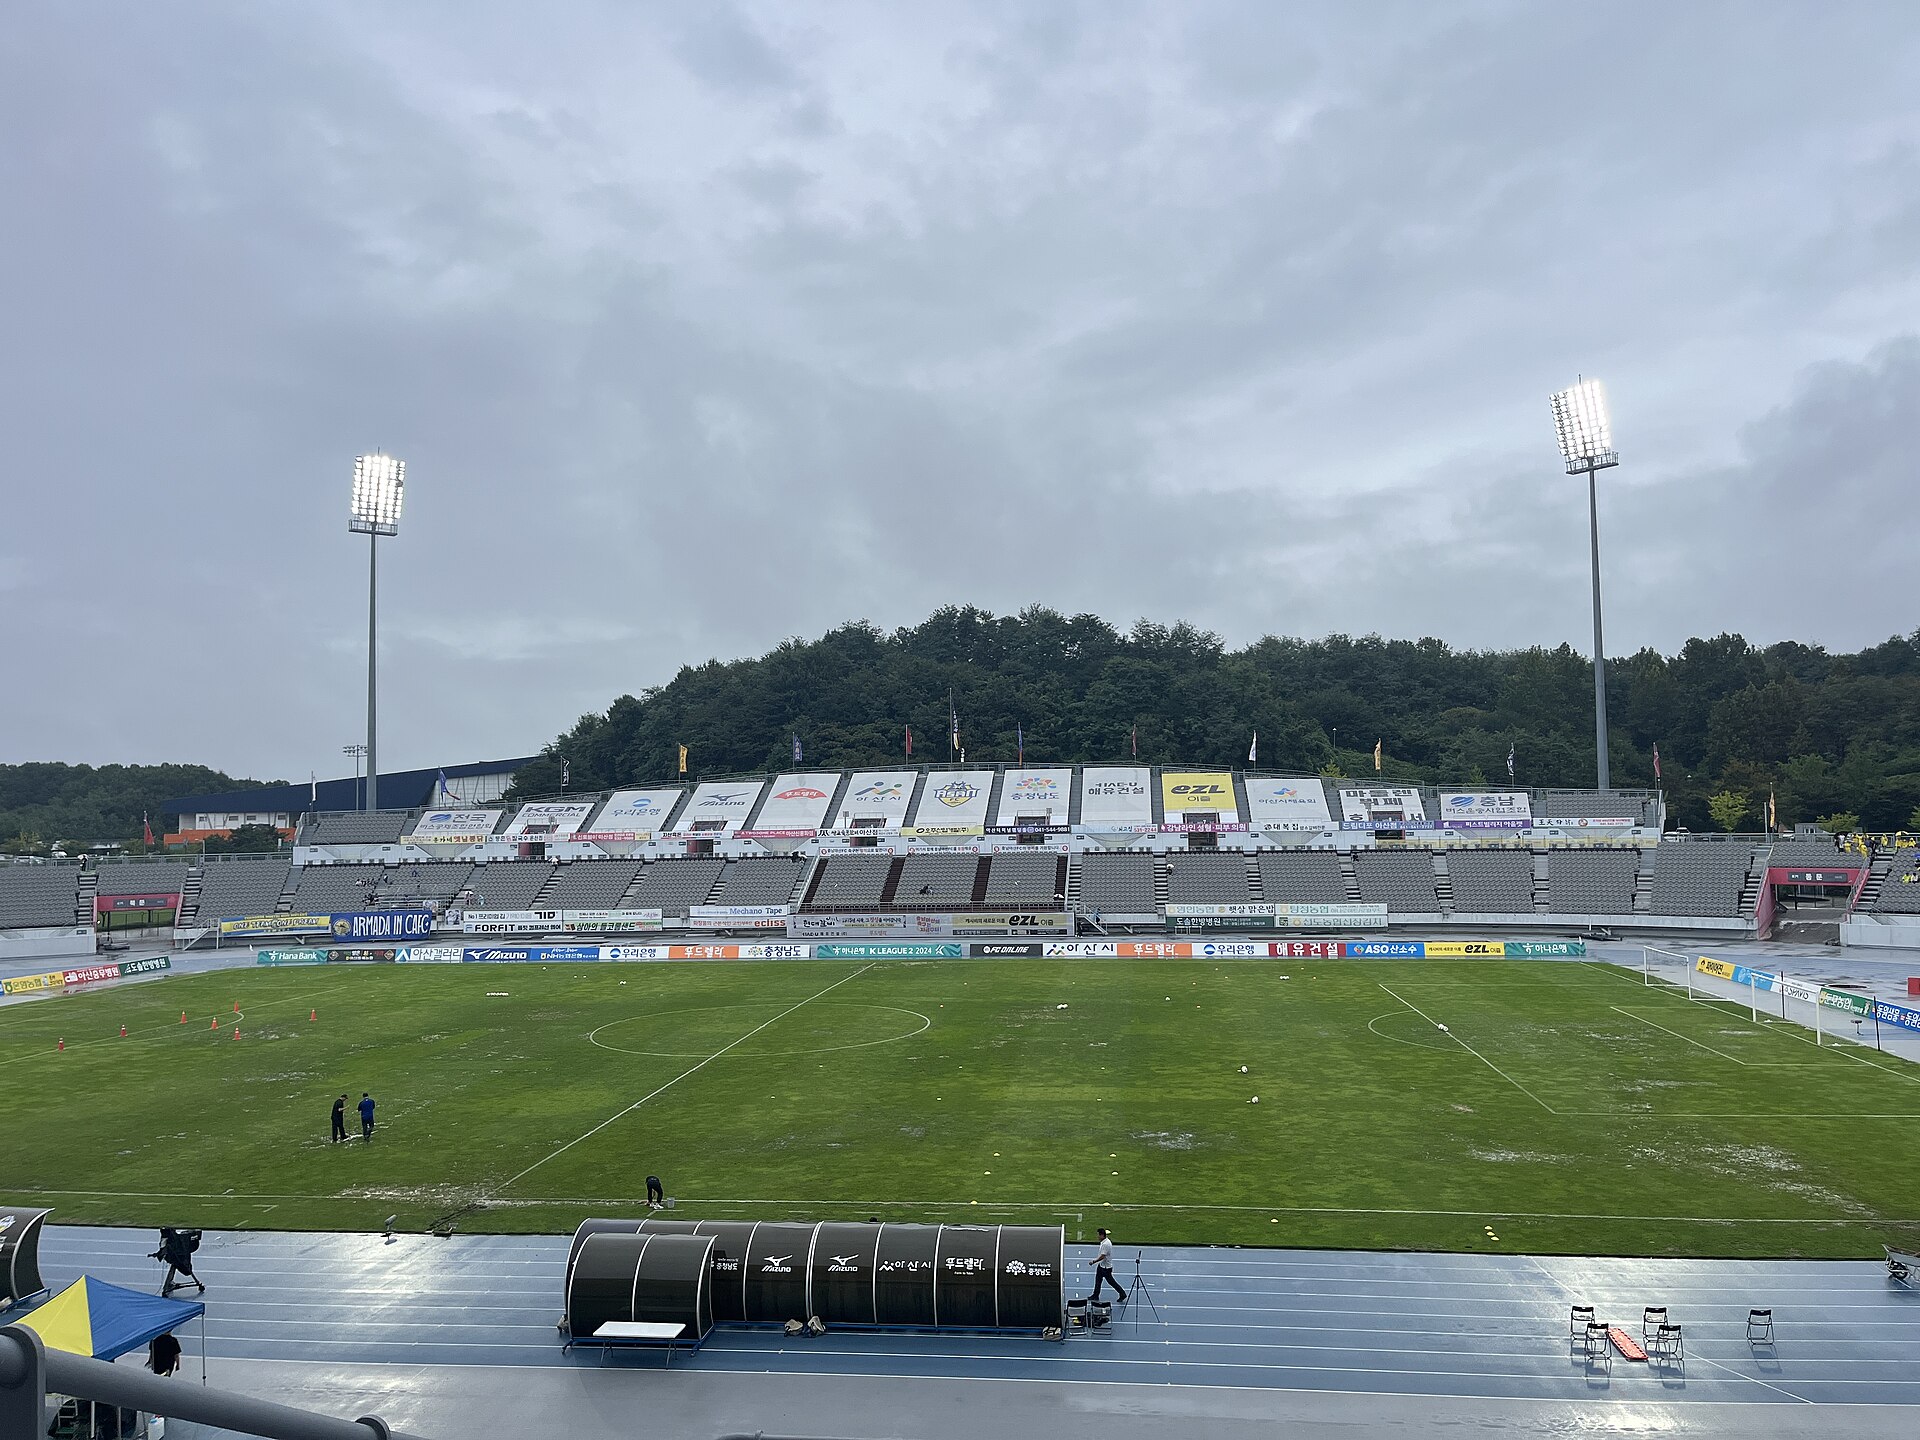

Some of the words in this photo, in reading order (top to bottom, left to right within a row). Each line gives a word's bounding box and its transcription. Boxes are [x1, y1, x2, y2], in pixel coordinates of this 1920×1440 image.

[1011, 792, 1060, 800] 충청남도
[1088, 787, 1145, 795] 해유건설
[1480, 796, 1515, 807] 충남
[612, 808, 661, 817] 우리은행
[453, 813, 487, 823] 전국
[233, 922, 249, 930] ONE
[251, 919, 273, 929] TEAM
[276, 918, 291, 927] ONE
[292, 917, 319, 926] DREAM
[352, 915, 390, 937] ARMADA
[393, 914, 402, 935] IN
[405, 914, 429, 935] CAFC
[475, 924, 515, 932] FORFIT
[754, 919, 786, 927] ecliss
[622, 948, 657, 958] 우리은행
[764, 946, 801, 957] 충청남도
[870, 947, 876, 955] K
[877, 947, 907, 955] LEAGUE
[915, 947, 932, 955] 2024
[1066, 943, 1114, 956] 아산시
[1217, 944, 1255, 955] 우리은행
[1276, 943, 1339, 956] 해유건설
[1365, 945, 1389, 954] ASO
[1390, 945, 1417, 954] 산소수
[1535, 944, 1567, 953] 하나은행
[279, 952, 298, 960] Hana
[299, 952, 317, 960] Bank
[413, 948, 462, 960] 아산갤러리
[485, 950, 527, 960] MIZUNO
[761, 1264, 792, 1273] MIZUNO
[828, 1264, 858, 1272] MIZUNO
[894, 1260, 931, 1272] 아산시
[945, 1257, 985, 1270] 푸드렐라
[1028, 1268, 1051, 1276] 충청남도
